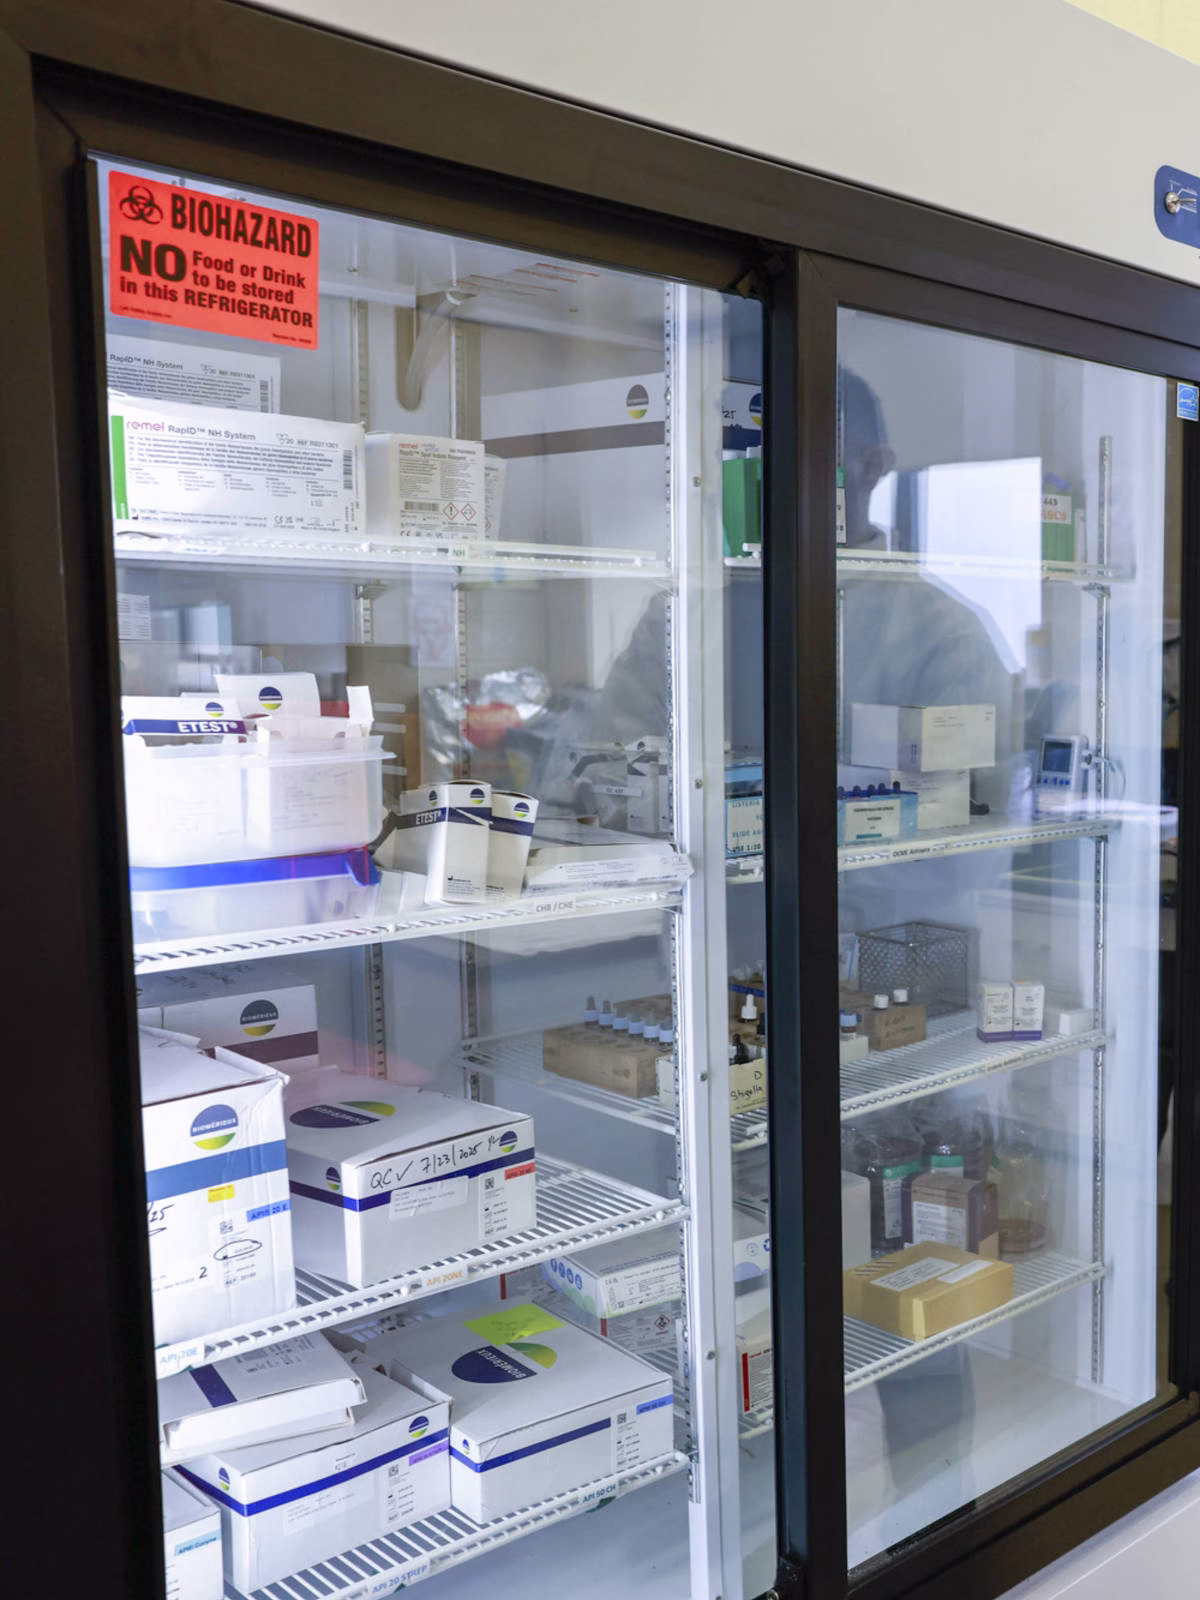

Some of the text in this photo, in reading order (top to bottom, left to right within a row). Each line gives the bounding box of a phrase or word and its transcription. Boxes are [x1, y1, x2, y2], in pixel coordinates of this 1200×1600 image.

[170, 192, 311, 258] BIOHAZARD
[120, 234, 306, 289] NO Food or Drink
[192, 270, 294, 305] to be stored
[120, 275, 313, 328] in this REFRIGERATOR
[143, 358, 155, 367] NH
[156, 360, 183, 371] System
[126, 420, 256, 442] remel RapID™ NH System
[177, 721, 238, 733] ETEST®
[371, 1168, 392, 1190] QC
[271, 1204, 281, 1214] 20
[199, 1266, 208, 1279] 2
[582, 1483, 617, 1503] API 50 CH
[373, 1564, 428, 1593] API 20 STREP
